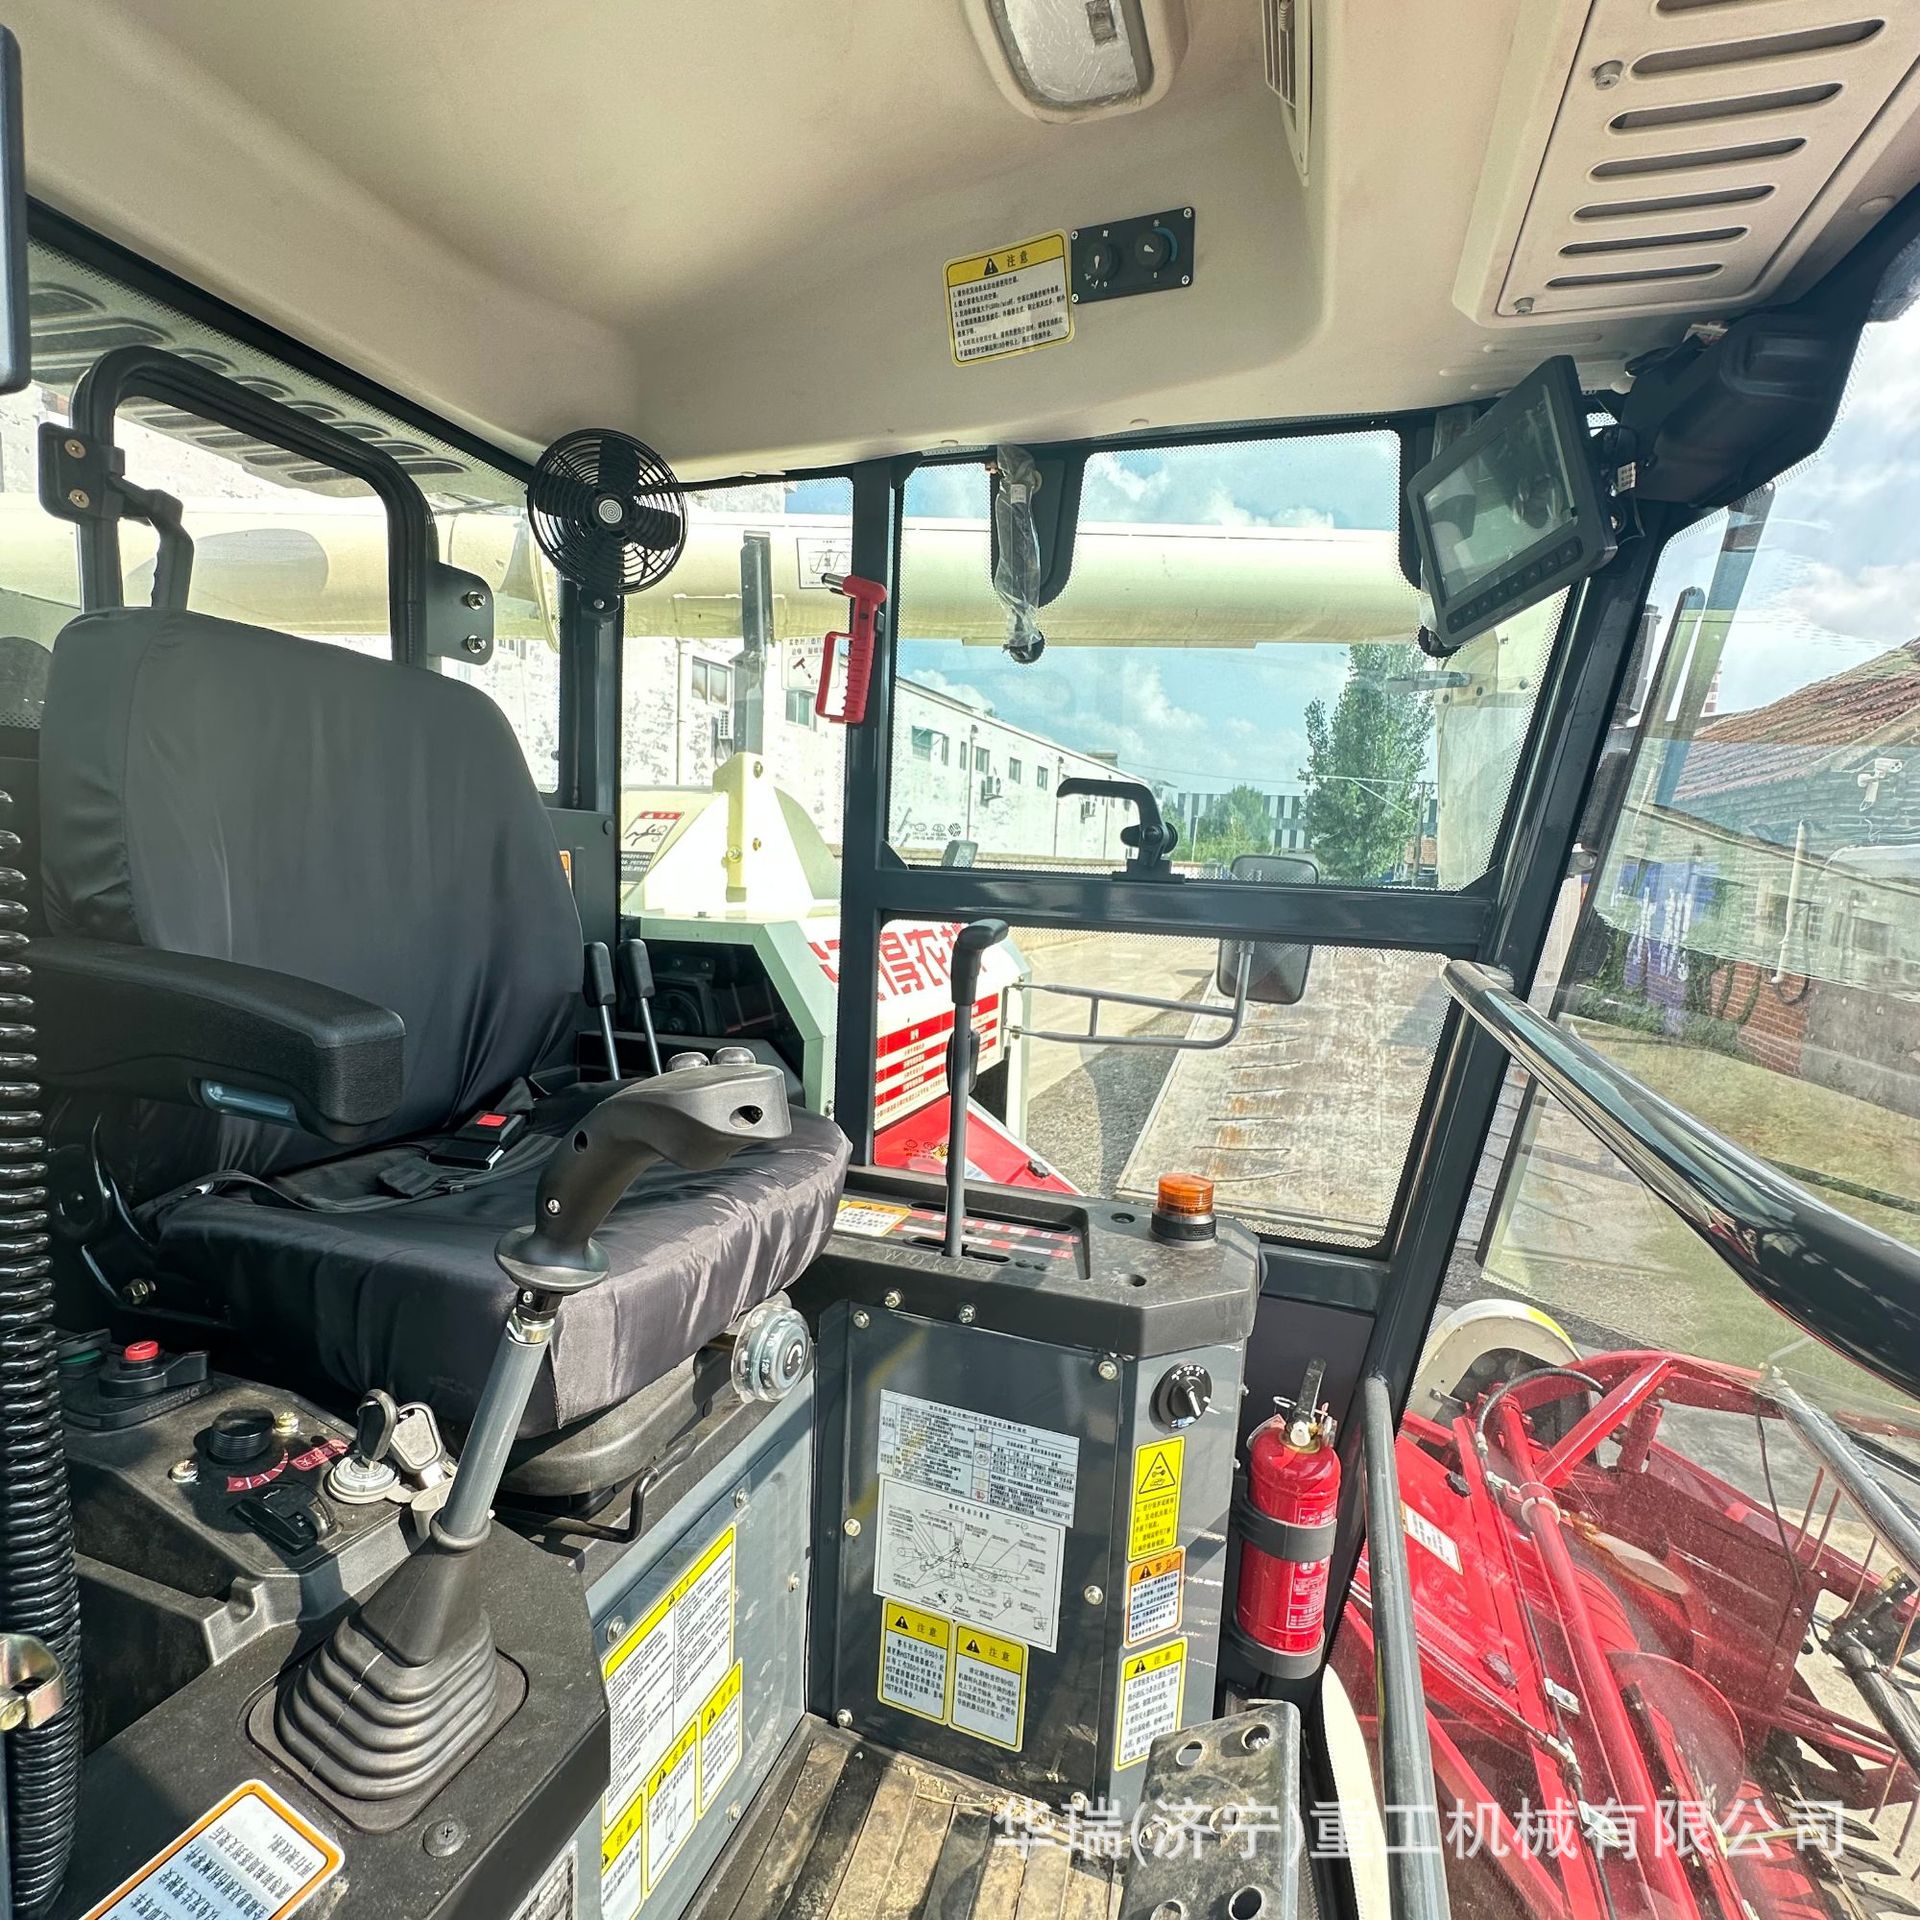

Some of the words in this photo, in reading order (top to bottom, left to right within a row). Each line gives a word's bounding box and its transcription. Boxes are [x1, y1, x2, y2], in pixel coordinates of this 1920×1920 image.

[1006, 250, 1028, 268] 注意
[917, 1623, 936, 1637] 注意
[988, 1647, 1010, 1661] 注意
[208, 1824, 293, 1900] 需等卸粮筒落到支架后
